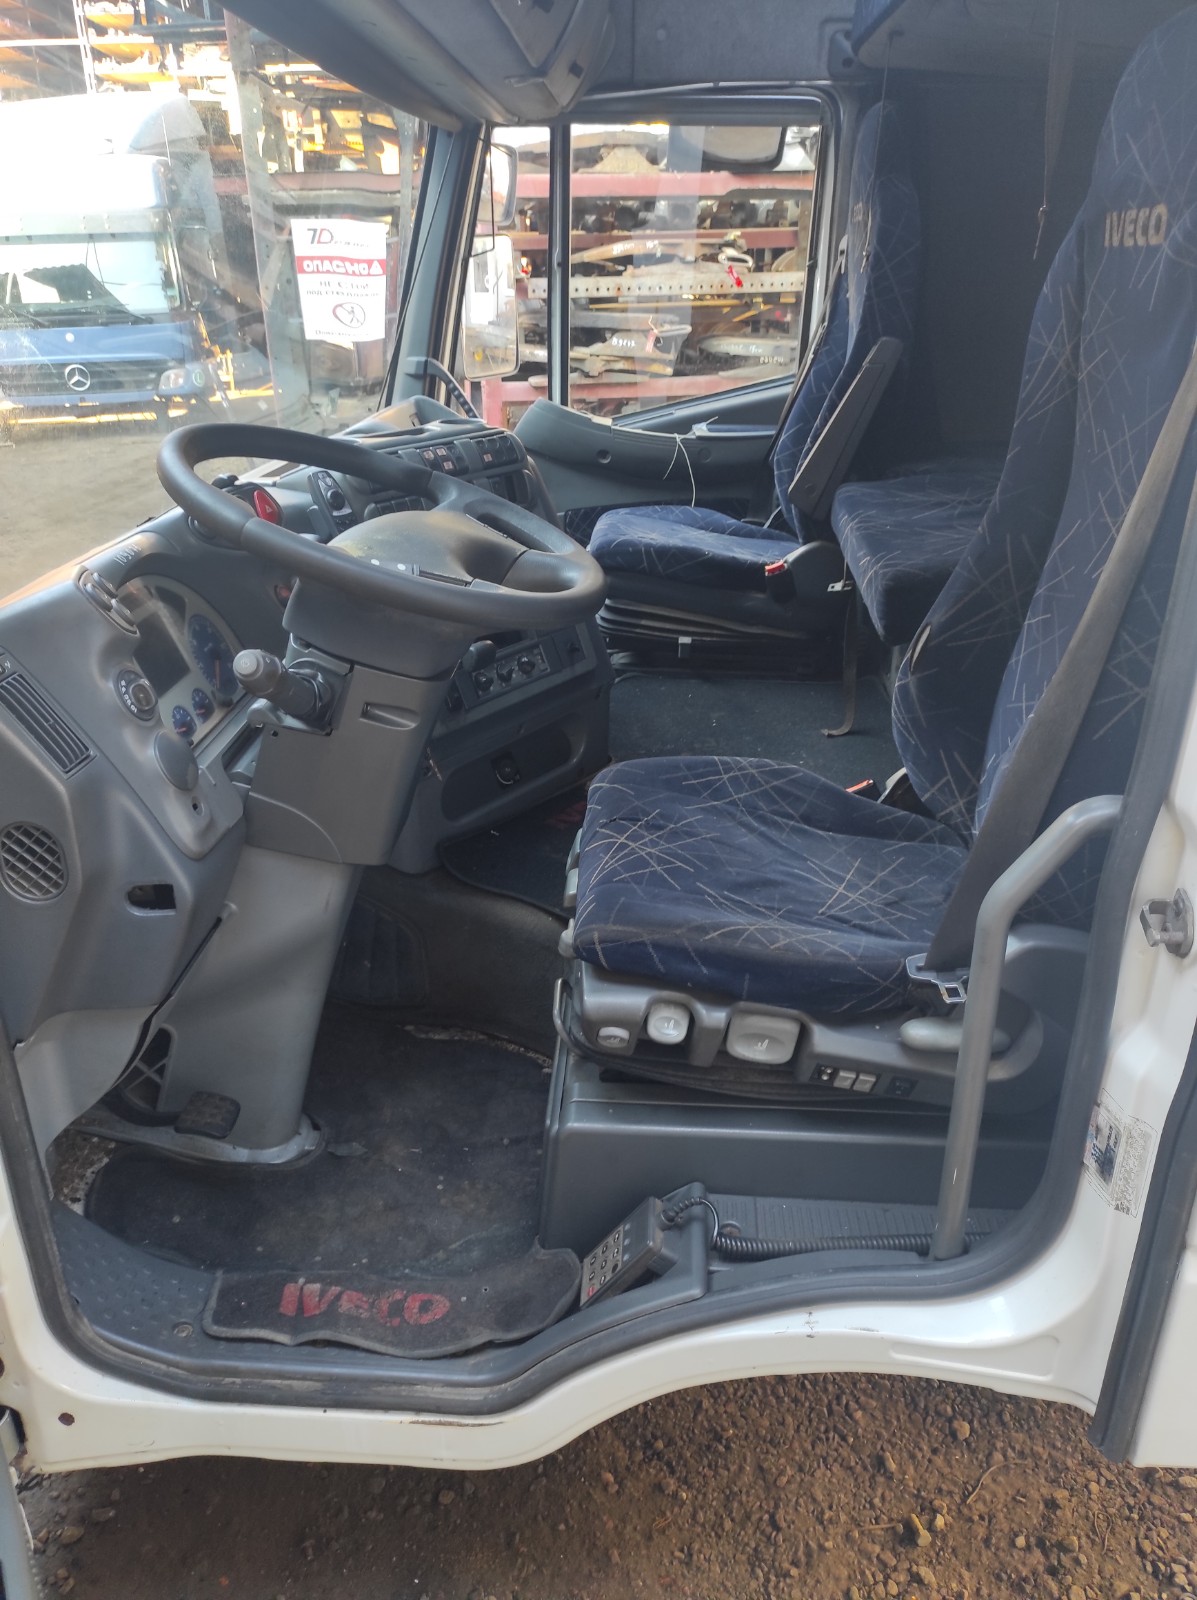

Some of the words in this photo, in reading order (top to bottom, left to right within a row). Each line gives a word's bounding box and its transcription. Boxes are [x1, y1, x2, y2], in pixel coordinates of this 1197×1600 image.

[1104, 203, 1168, 247] IVECO
[303, 260, 369, 275] ОПАСНО
[279, 1283, 450, 1326] IVECO
